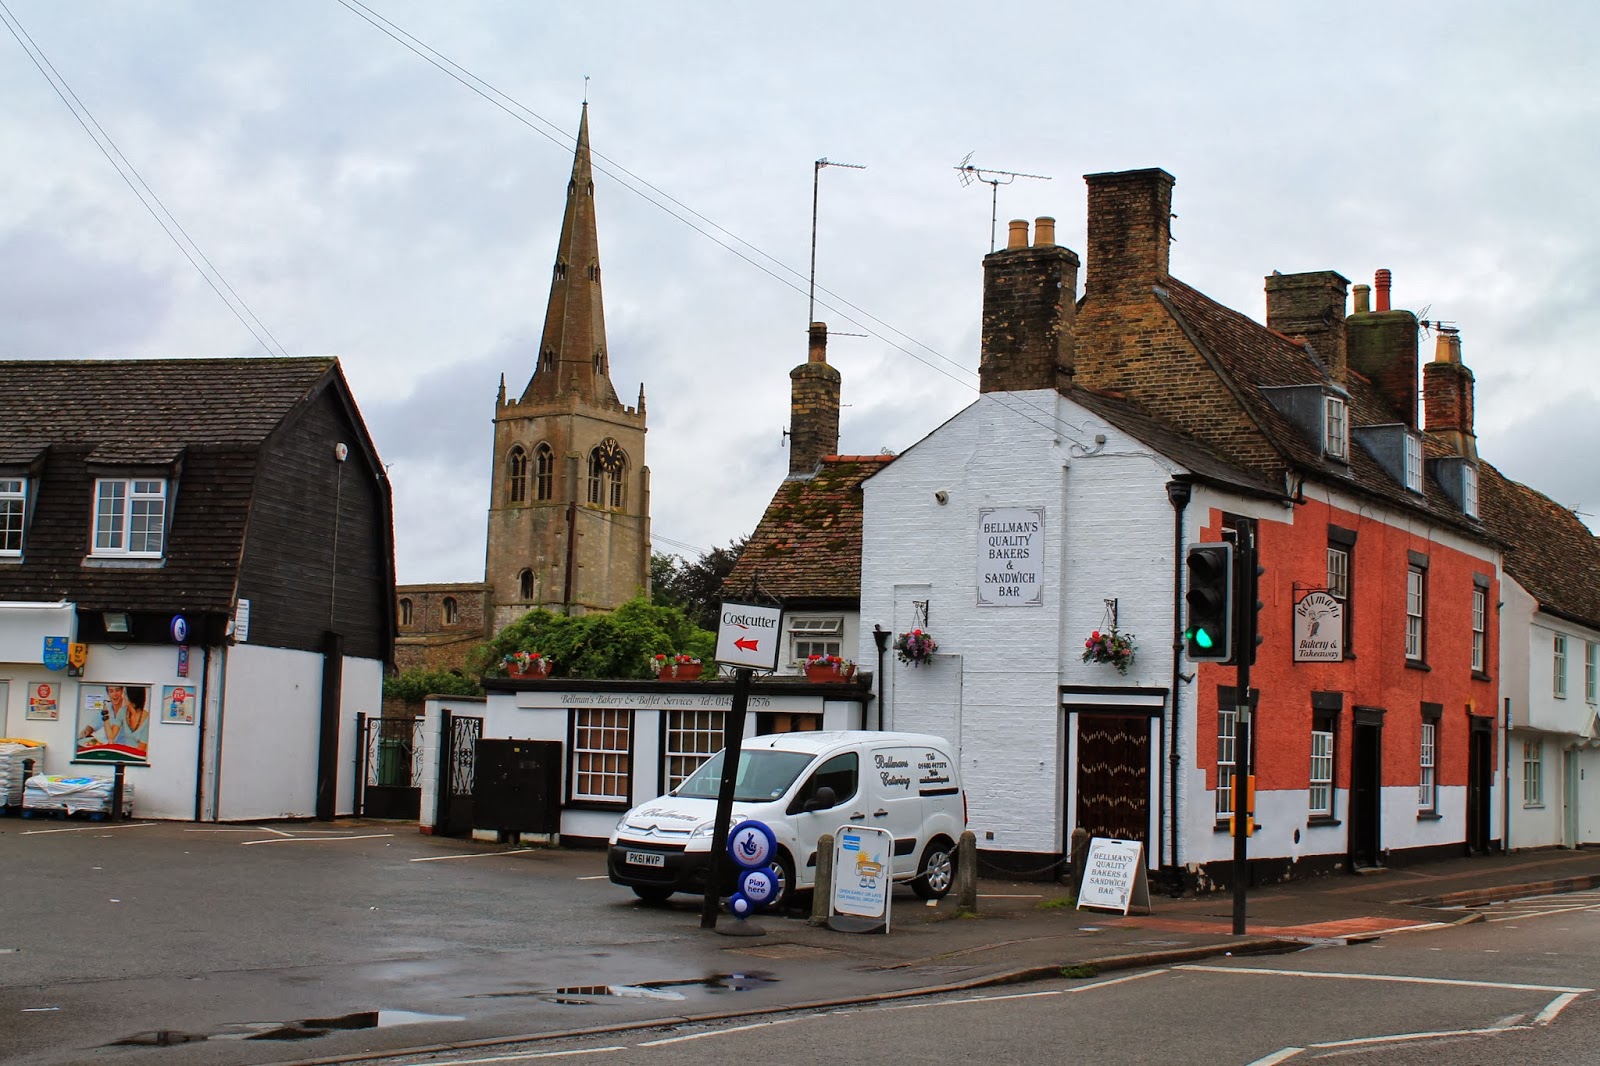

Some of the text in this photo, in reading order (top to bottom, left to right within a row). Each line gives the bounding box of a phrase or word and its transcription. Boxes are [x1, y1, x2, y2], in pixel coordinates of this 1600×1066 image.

[983, 522, 1038, 533] BELLMAN'S
[988, 533, 1032, 547] QUALITY
[989, 548, 1030, 559] BAKERS
[1006, 560, 1014, 570] &
[984, 571, 1035, 583] SANDWICH
[998, 586, 1020, 597] BAR
[1297, 595, 1340, 618] Bellmans
[723, 611, 776, 628] Costcutter
[1299, 639, 1337, 650] Bakery &
[1298, 649, 1339, 660] Takeaway
[560, 693, 594, 704] Bellman's
[595, 694, 623, 707] Bakery
[624, 695, 634, 705] &
[636, 694, 661, 708] Buffet
[663, 696, 693, 706] Services
[715, 696, 734, 707] 0148
[747, 697, 771, 707] 17576
[880, 771, 911, 790] Catering
[629, 853, 661, 865] PK61 MVP
[1093, 852, 1133, 863] BELLMAN'S
[1095, 860, 1128, 870] QUALITY
[1091, 869, 1121, 878] BAKERS
[748, 878, 766, 888] Play
[1089, 877, 1127, 887] SANDWICH
[747, 885, 766, 894] here
[1098, 886, 1114, 895] BAR
